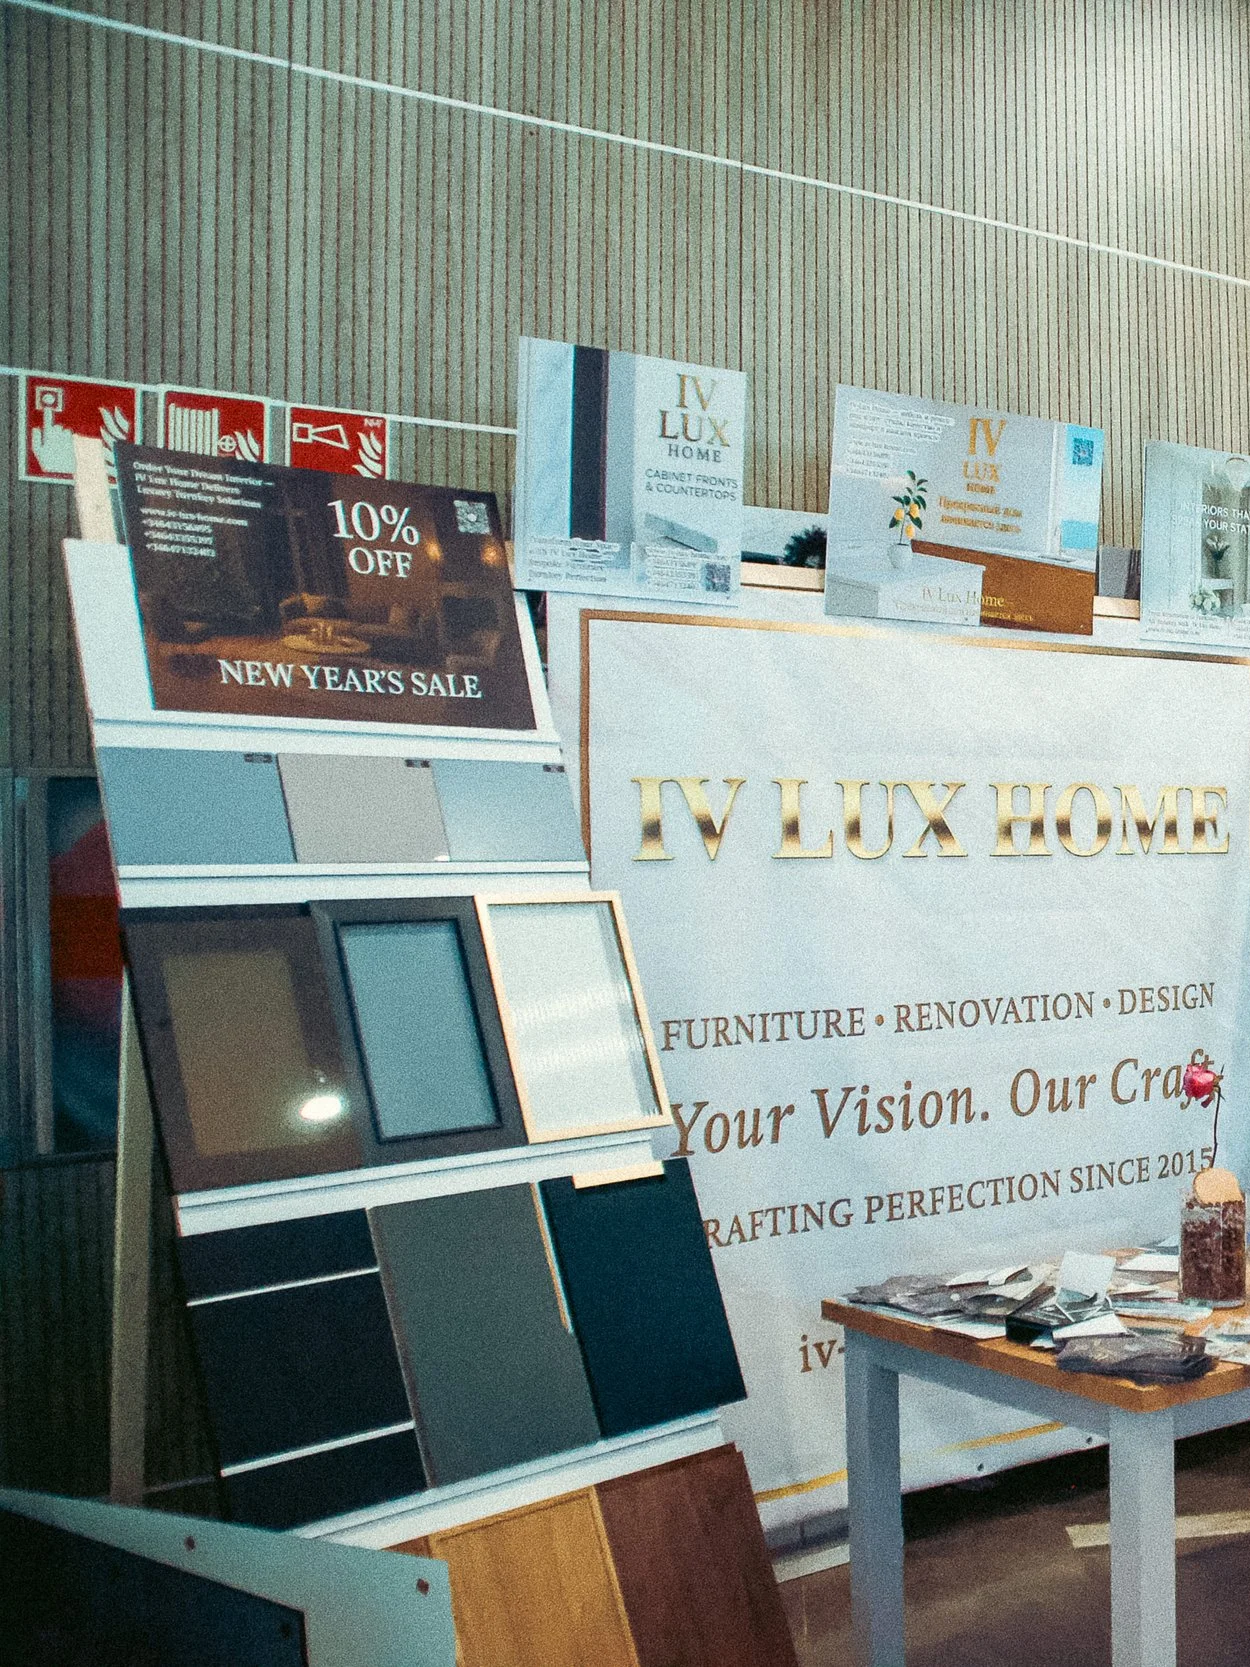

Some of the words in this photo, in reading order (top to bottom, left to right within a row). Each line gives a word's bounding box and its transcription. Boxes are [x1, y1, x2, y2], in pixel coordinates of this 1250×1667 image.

[676, 373, 717, 411] IV
[659, 409, 730, 447] LUX
[967, 417, 1007, 456] IV
[668, 443, 722, 462] HOME
[962, 459, 1003, 483] LUX
[645, 468, 692, 482] CABINET
[696, 474, 738, 489] FRONTS
[656, 483, 737, 501] COUNTERTOPS
[327, 499, 422, 546] 10%
[1203, 518, 1229, 531] YOUR
[348, 547, 413, 578] OFF
[217, 659, 295, 689] NEW
[410, 671, 483, 700] SALE
[630, 776, 747, 862] IV
[771, 778, 969, 860] LUX
[988, 781, 1230, 859] HOME
[660, 1006, 866, 1052] FURNITURE
[893, 990, 1096, 1035] RENOVATION
[1117, 981, 1216, 1016] DESIGN
[670, 1100, 795, 1156] Your
[811, 1080, 991, 1140] Vision.
[1009, 1066, 1097, 1119] Our
[703, 1197, 854, 1249] RAFTING
[864, 1170, 1063, 1226] PERFECTION
[1068, 1156, 1152, 1195] SINCE
[1156, 1147, 1214, 1180] 2015
